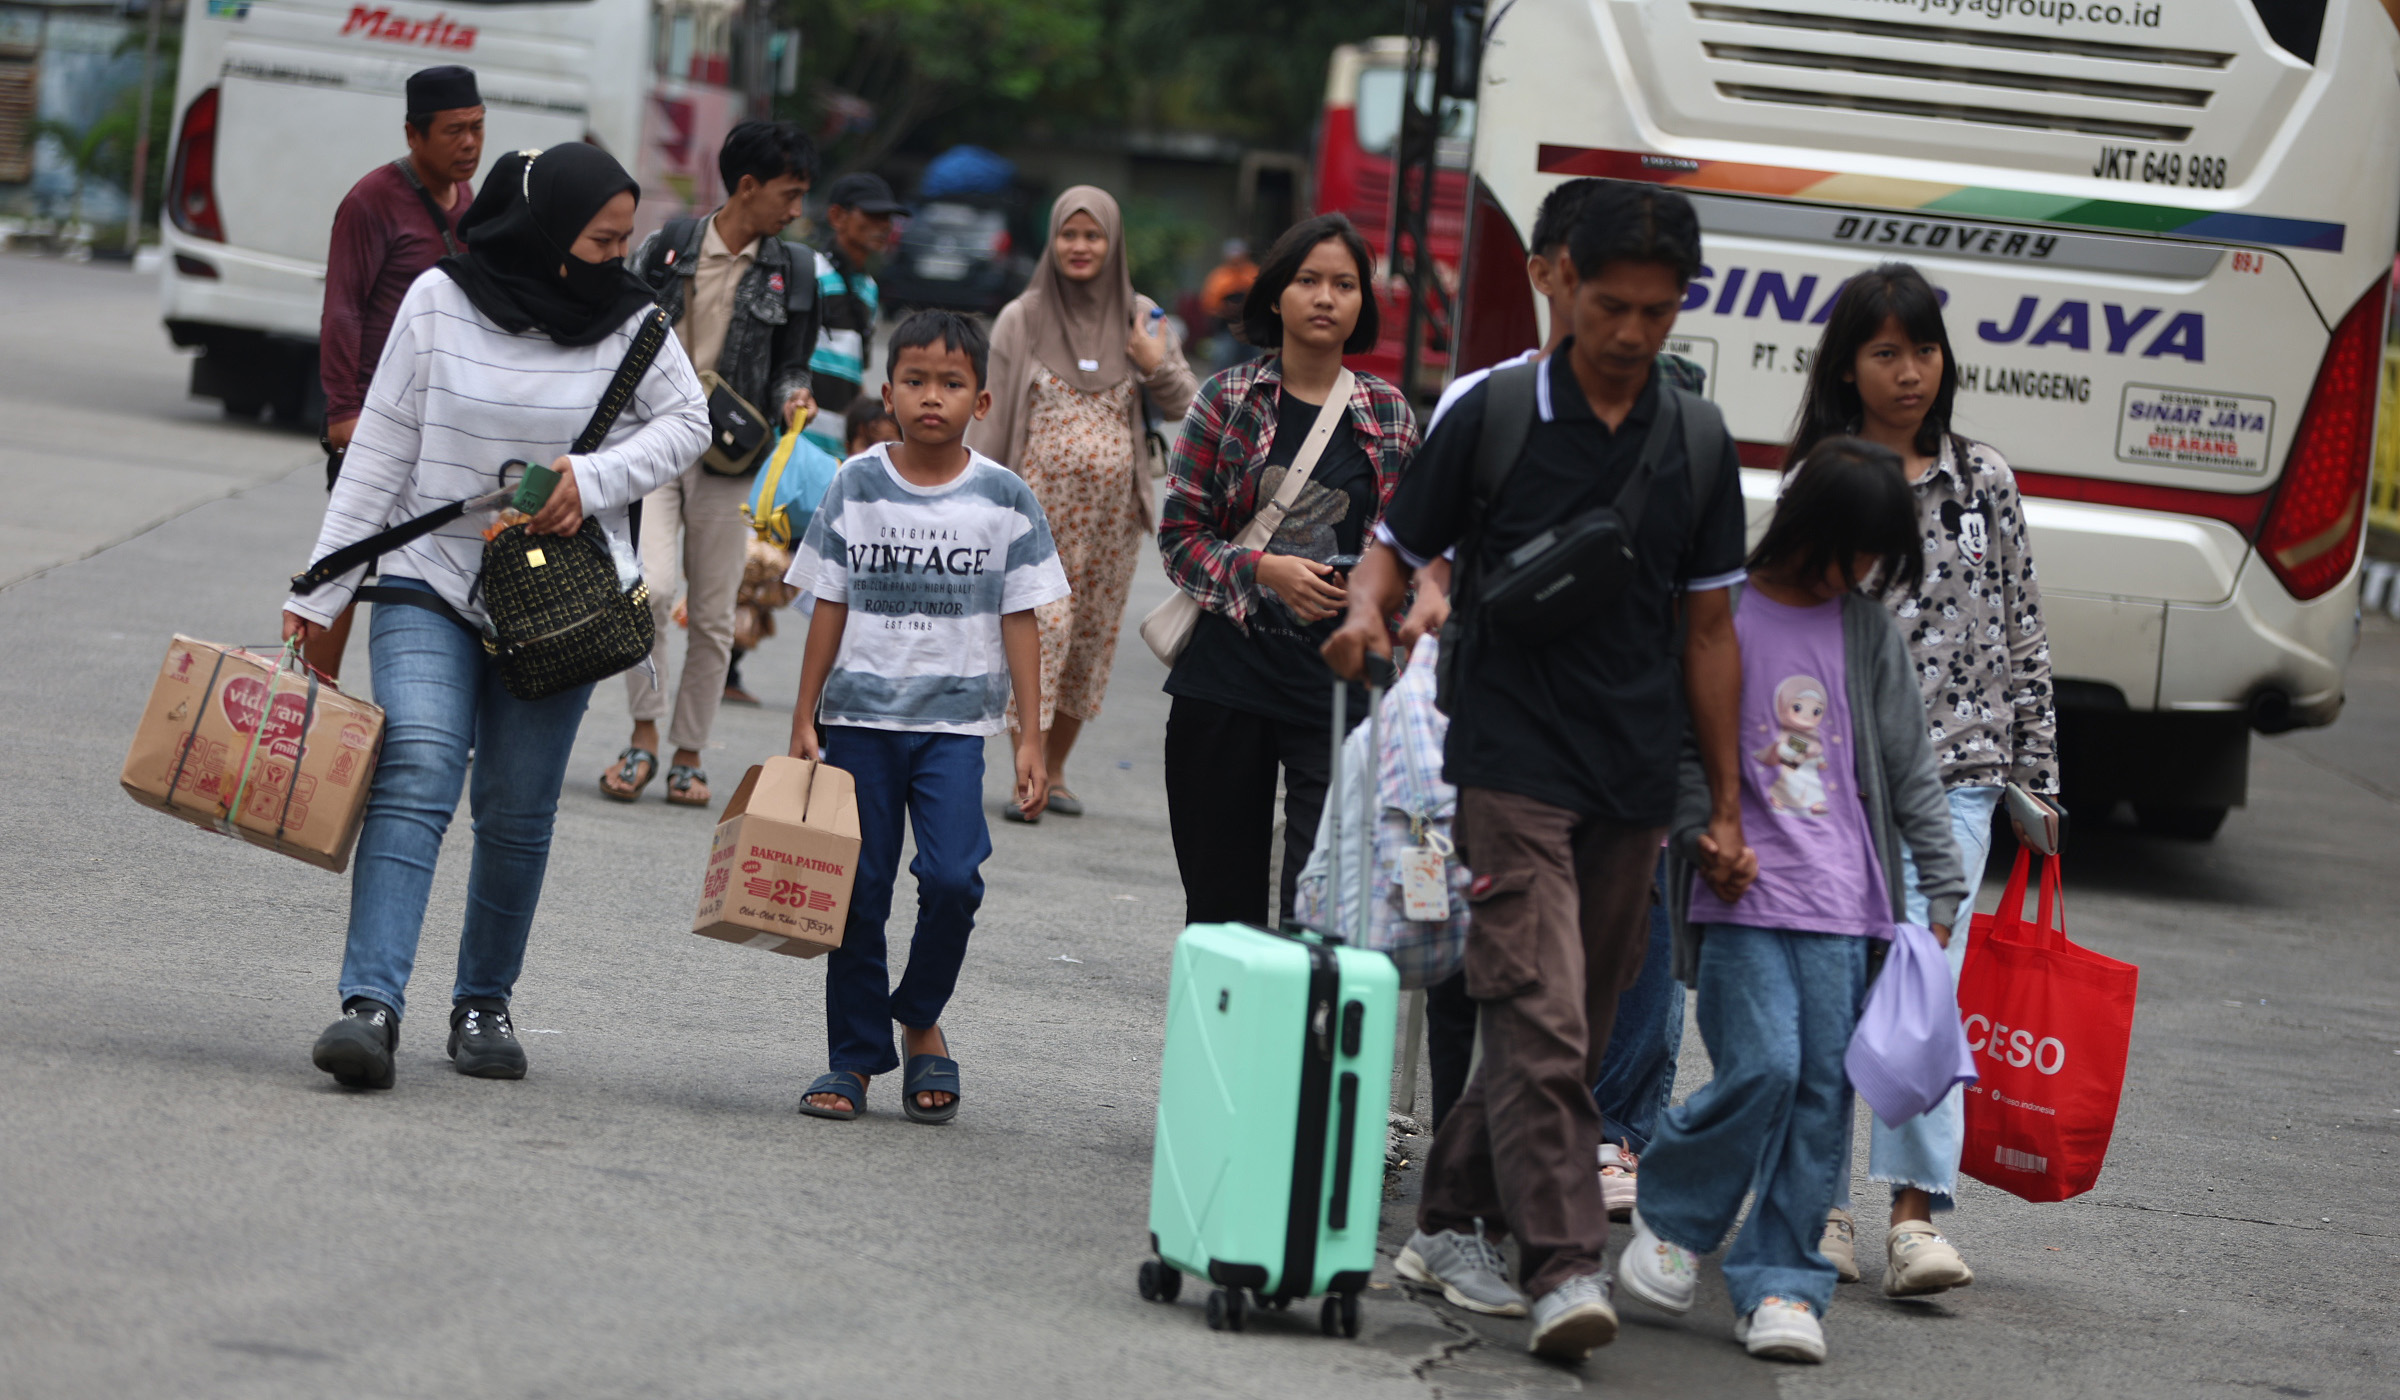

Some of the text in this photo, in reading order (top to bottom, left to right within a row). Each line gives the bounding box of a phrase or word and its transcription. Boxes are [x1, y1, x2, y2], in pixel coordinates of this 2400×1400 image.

[340, 3, 480, 51] Marita
[2093, 146, 2227, 189] JKT 649 988
[1834, 216, 2058, 259] DISCOVERY
[1977, 296, 2206, 364] JAYA
[1985, 365, 2091, 403] LANGGENG
[2129, 401, 2265, 433] SINAR JAYA
[2148, 434, 2238, 457] DILARANG
[881, 527, 959, 541] ORIGINAL
[848, 543, 991, 576] VINTAGE
[924, 583, 945, 593] HIGH
[865, 599, 964, 615] RODEO JUNIOR
[750, 845, 793, 865] BAKPIA
[795, 856, 844, 876] PATHOK
[770, 879, 808, 908] 25
[1960, 1009, 2065, 1075] CESO
